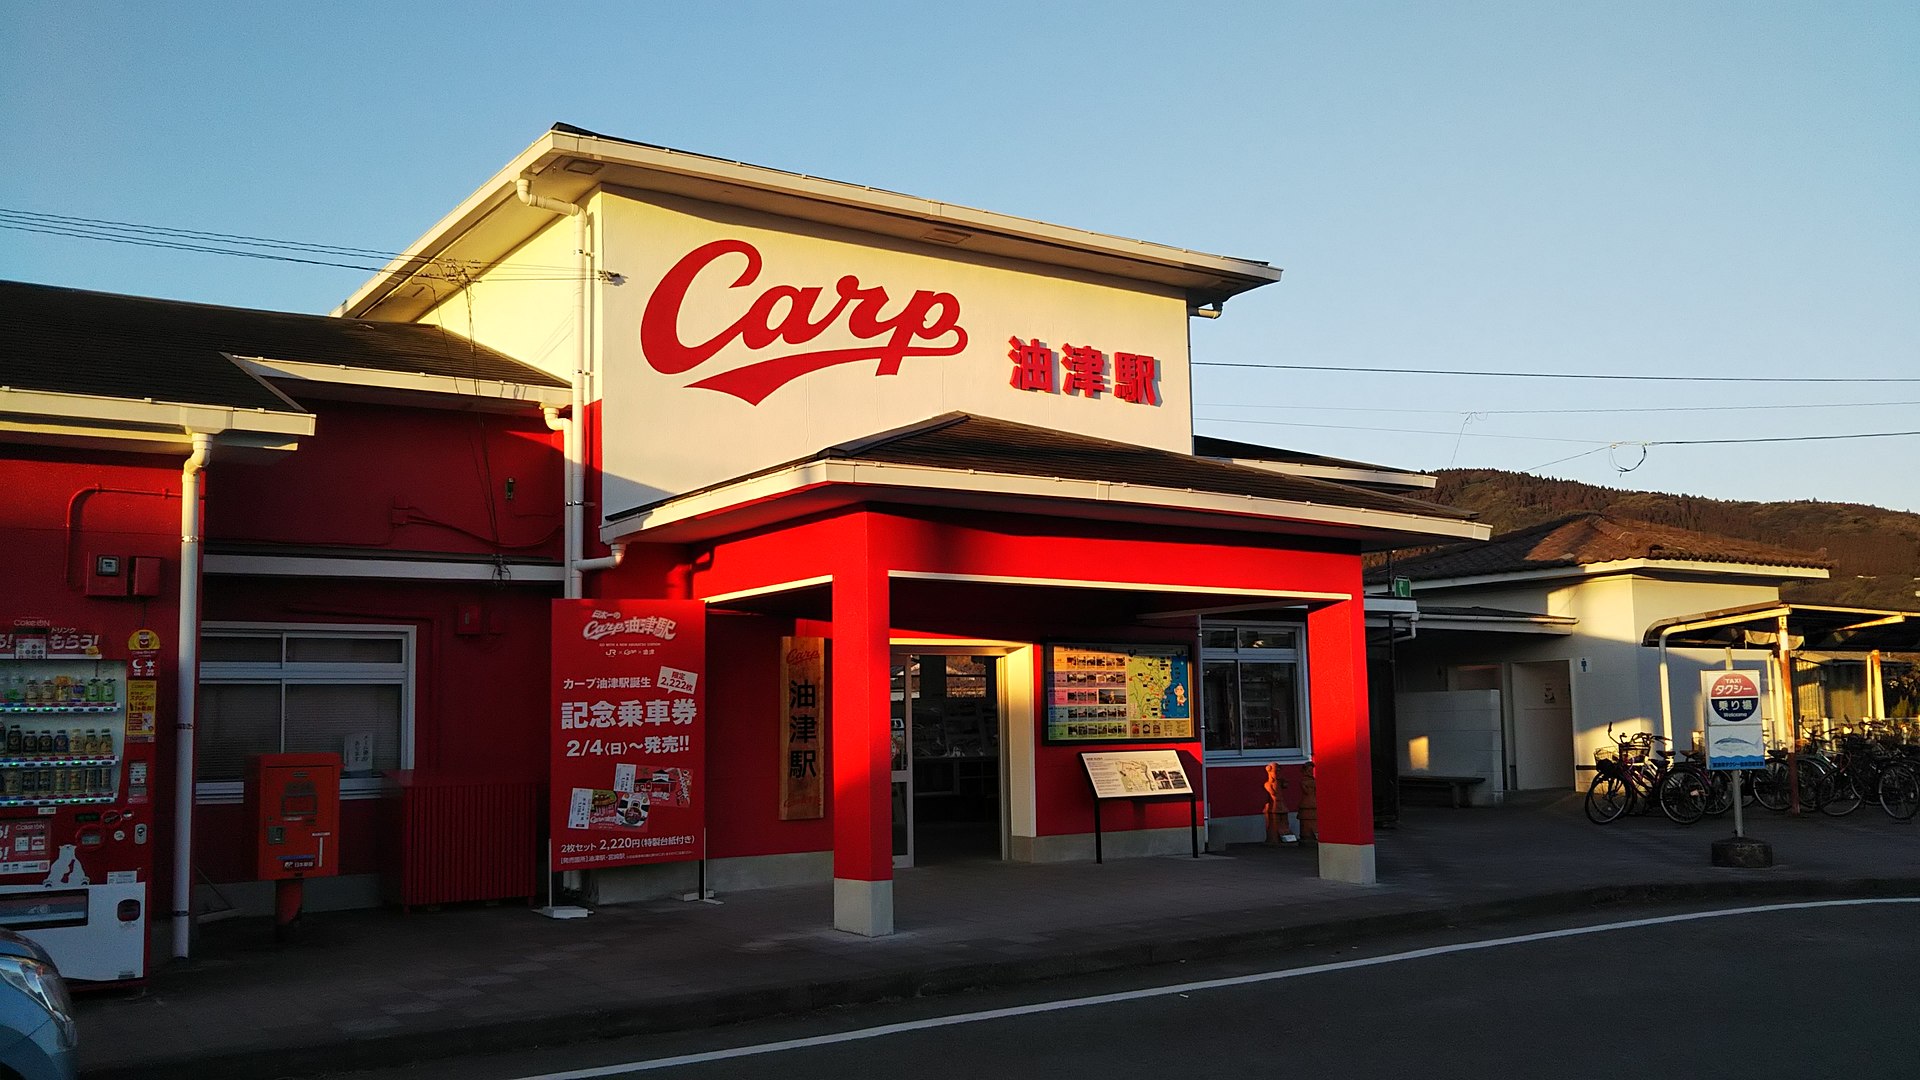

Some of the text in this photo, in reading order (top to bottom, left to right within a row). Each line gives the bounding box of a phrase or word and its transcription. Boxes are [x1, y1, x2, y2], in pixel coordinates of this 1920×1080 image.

[641, 239, 968, 406] Carp
[1008, 335, 1158, 405] 油津駅
[50, 634, 99, 650] もらう!
[786, 648, 820, 666] Carp
[563, 677, 652, 690] カープ油津駅誕生
[660, 677, 693, 692] 2,222枚
[1715, 684, 1752, 695] タクシー
[1718, 700, 1752, 711] 乗り場
[561, 698, 697, 730] 記念乗車券
[789, 679, 817, 779] 油津駅
[561, 843, 597, 854] 2枚セット
